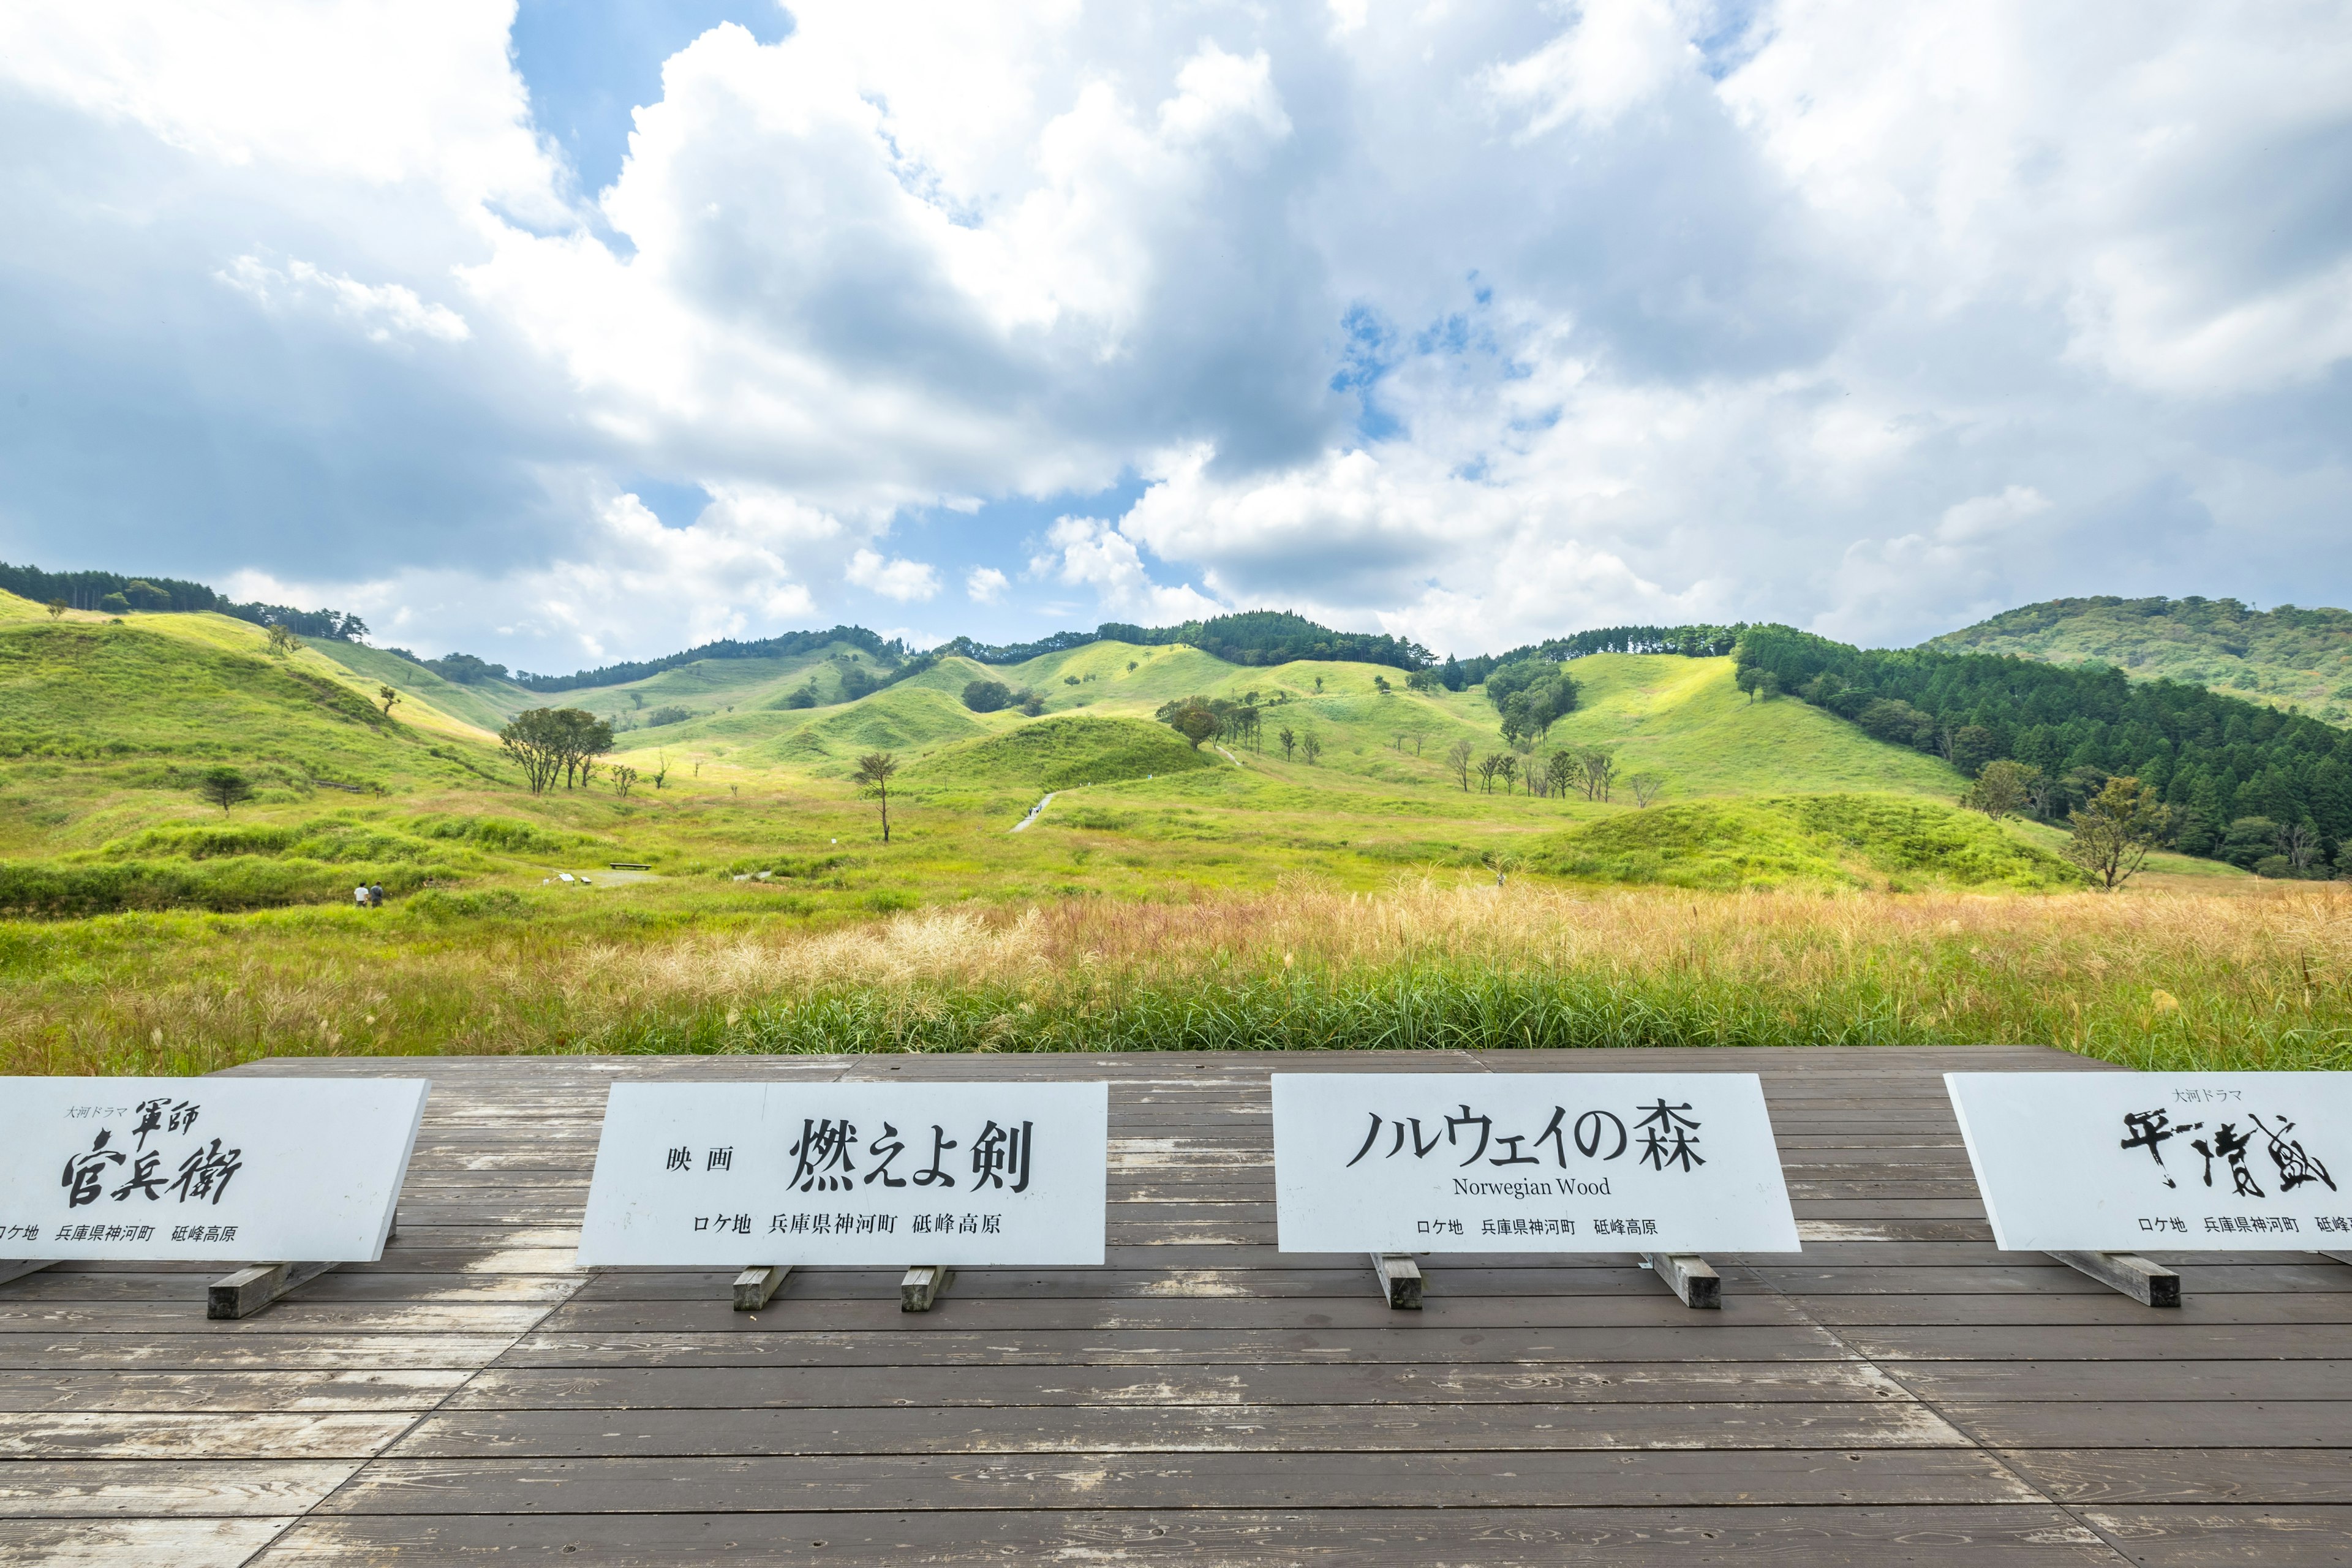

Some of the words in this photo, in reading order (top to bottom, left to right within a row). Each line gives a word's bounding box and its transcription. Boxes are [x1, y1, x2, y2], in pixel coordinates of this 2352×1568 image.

[2172, 1088, 2242, 1102] 大河ドラマ
[64, 1106, 127, 1119] 大河ドラマ
[132, 1098, 201, 1152] 軍師
[1346, 1098, 1707, 1173] ノルウェイの森
[666, 1145, 734, 1172] 映画
[786, 1118, 1034, 1194] 燃えよ剣
[2120, 1107, 2337, 1198] 平清盛
[62, 1127, 243, 1208] 官兵衛
[1453, 1177, 1553, 1200] Norwegian
[1556, 1177, 1611, 1196] Wood
[55, 1224, 154, 1242] 兵庫県神河町
[171, 1225, 238, 1242] 砥峰高原
[693, 1214, 752, 1234] ロケ地
[768, 1213, 899, 1235] 兵庫県神河町
[911, 1213, 1002, 1234] 砥峰高原
[1417, 1218, 1464, 1235] ロケ地
[1481, 1218, 1575, 1235] 兵庫県神河町
[1593, 1218, 1658, 1235] 砥峰高原
[2138, 1216, 2188, 1233] ロケ地
[2204, 1216, 2299, 1233] 兵庫県神河町
[2314, 1216, 2352, 1233] 砥峰
